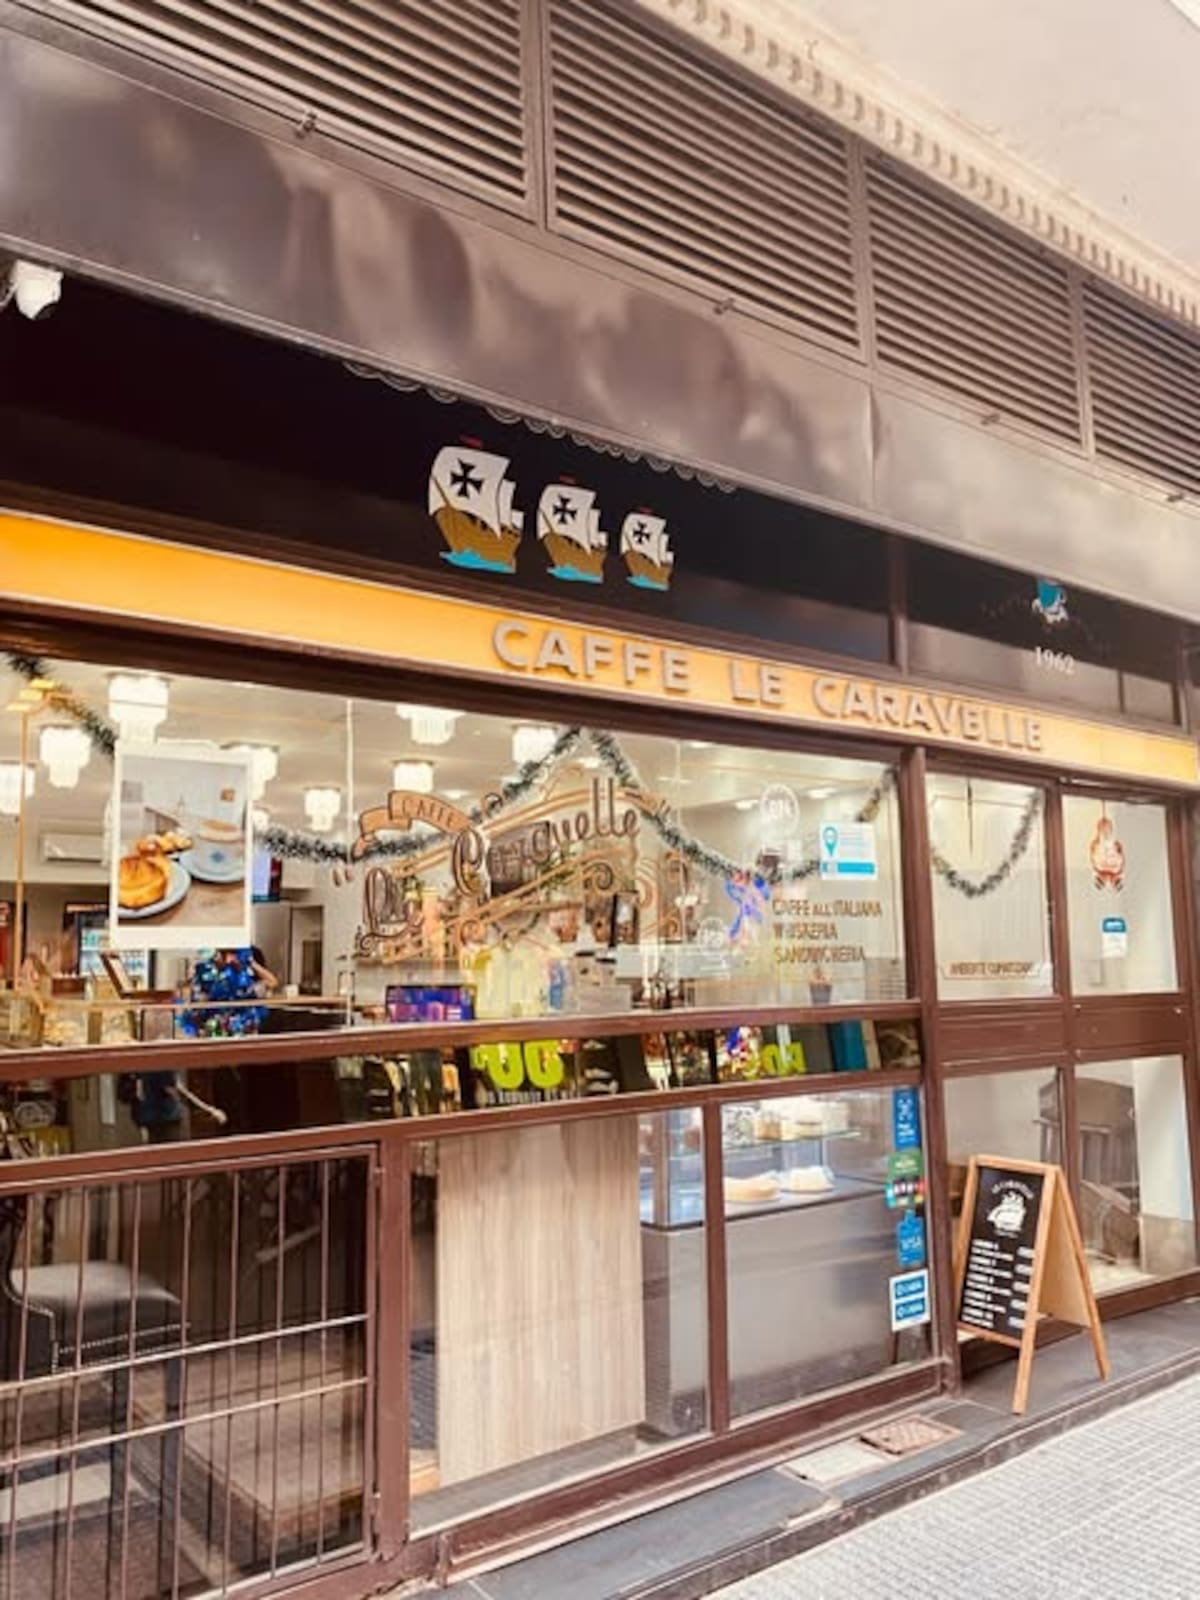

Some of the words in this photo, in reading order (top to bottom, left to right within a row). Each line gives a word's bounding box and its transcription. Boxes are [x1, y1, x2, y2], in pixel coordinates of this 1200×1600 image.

[492, 619, 690, 692] CAFFE
[730, 660, 785, 707] LE
[812, 675, 1043, 752] CARAVELLE
